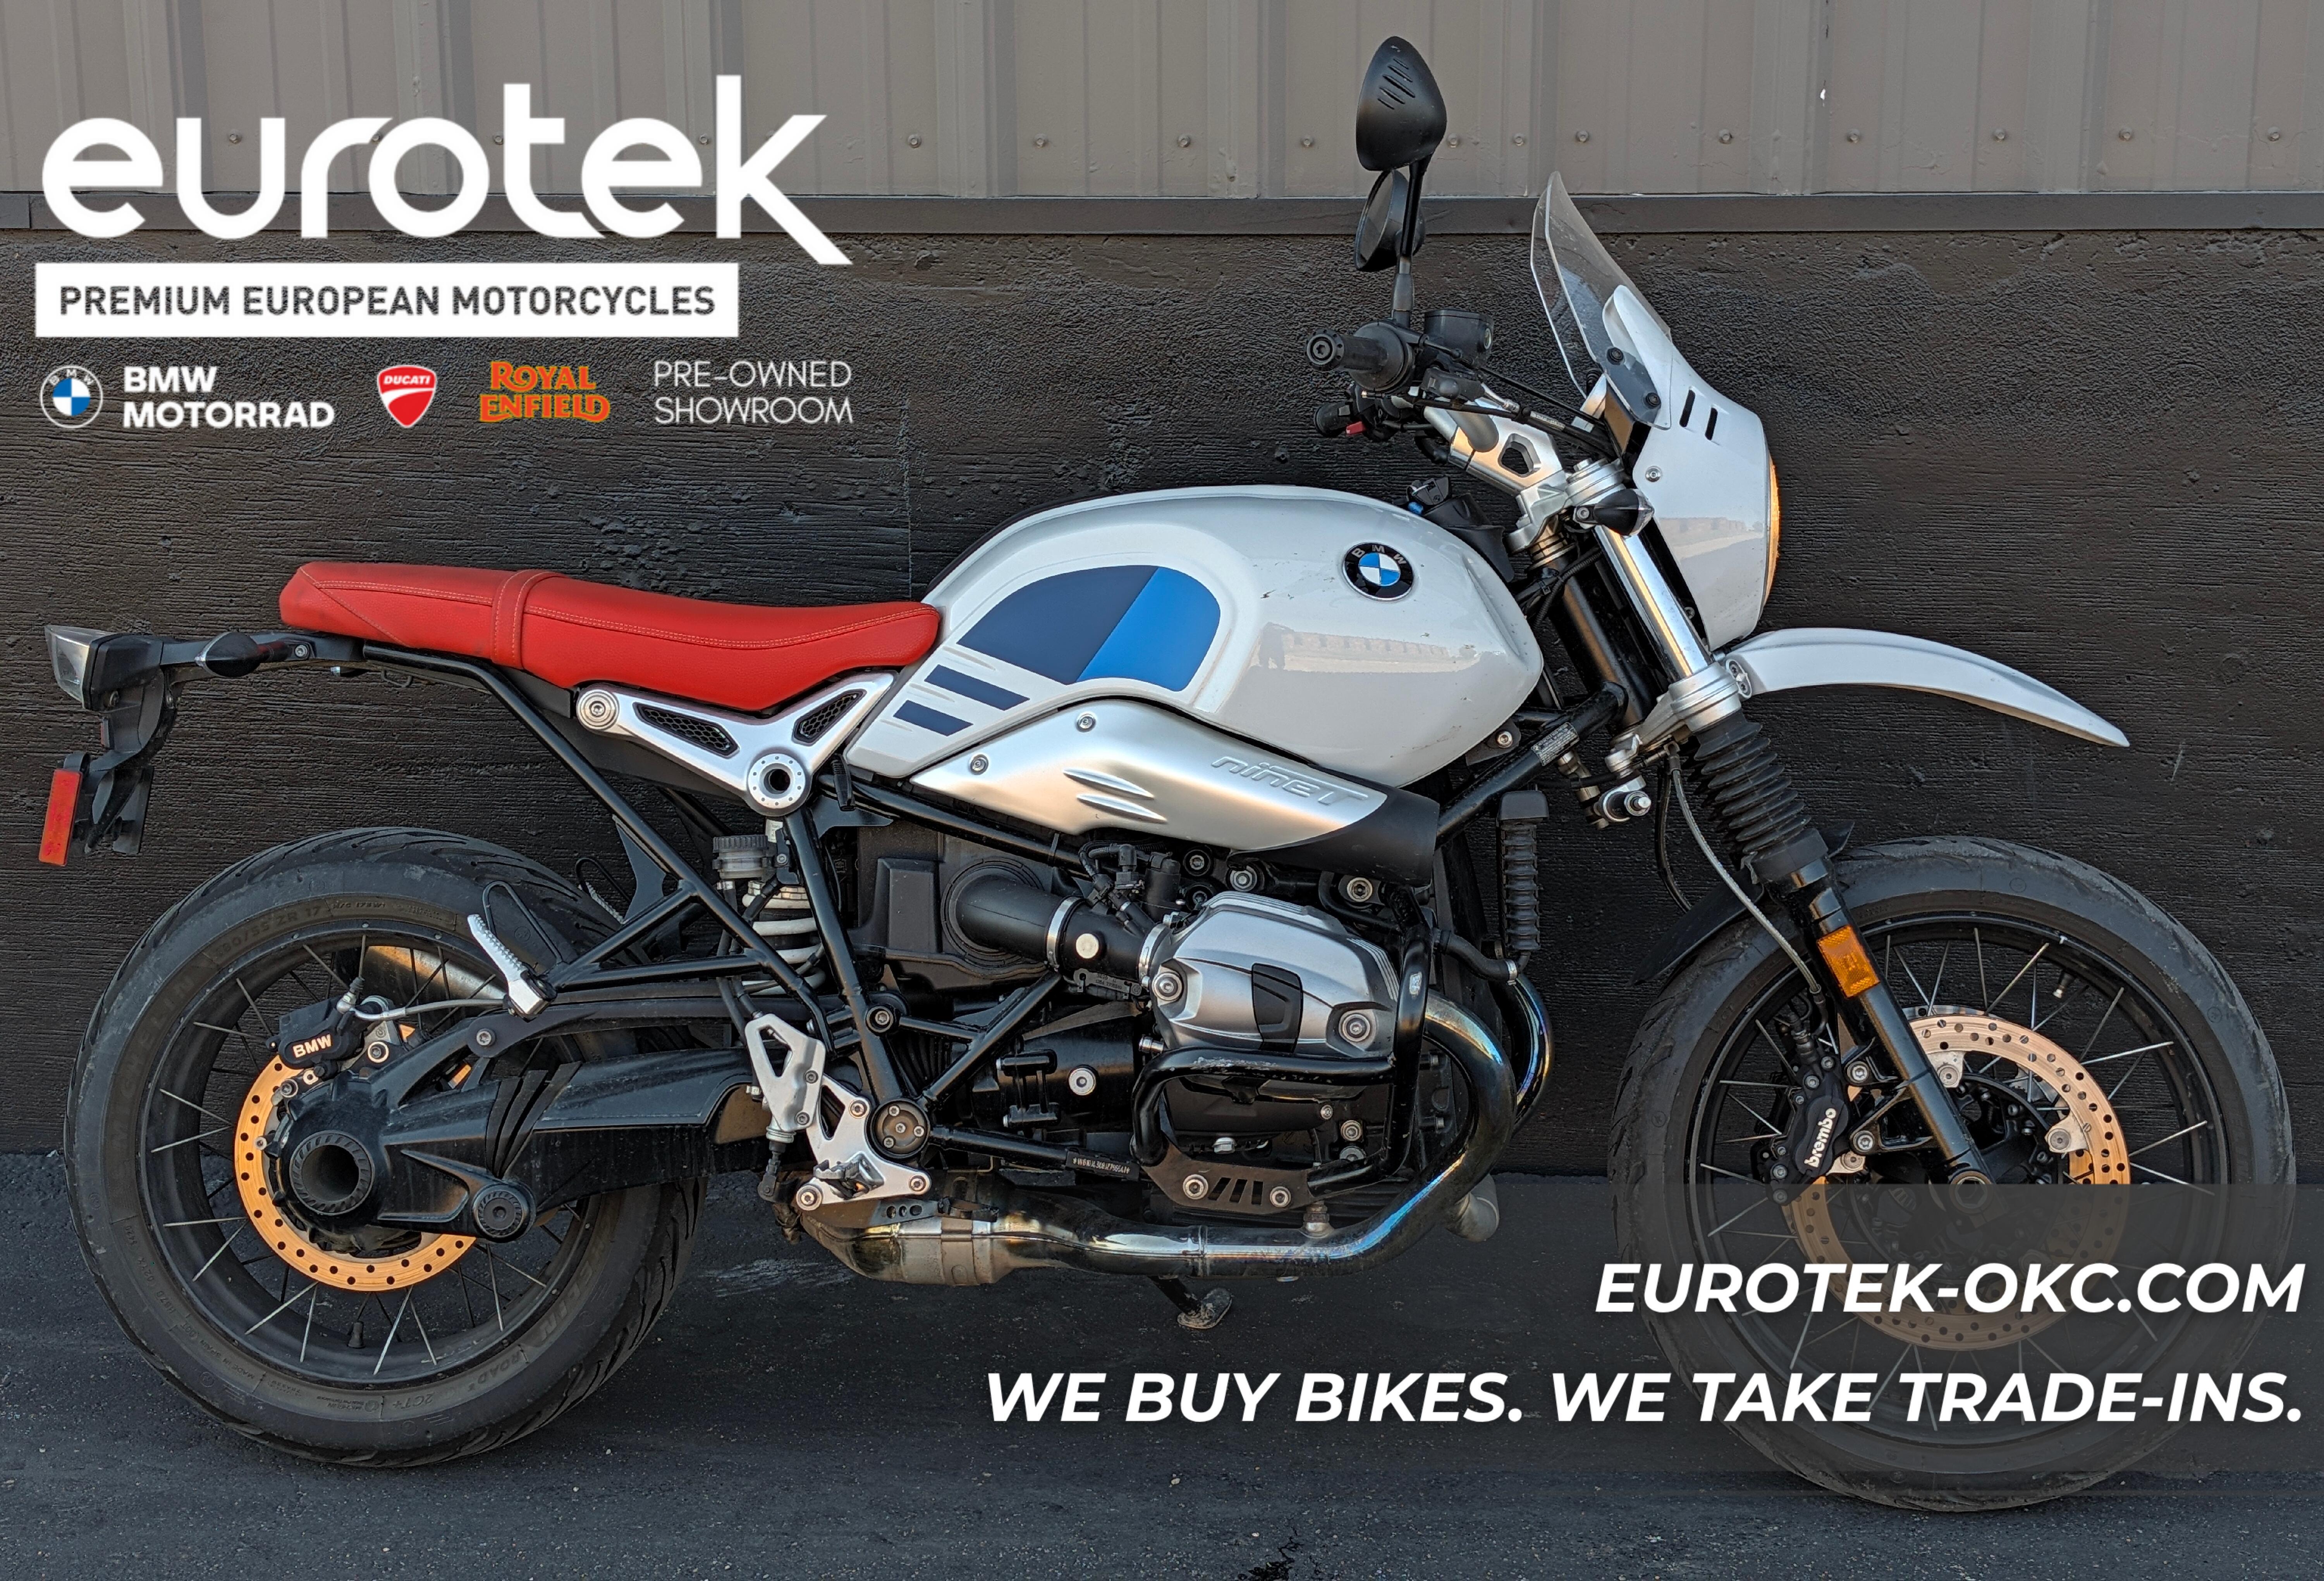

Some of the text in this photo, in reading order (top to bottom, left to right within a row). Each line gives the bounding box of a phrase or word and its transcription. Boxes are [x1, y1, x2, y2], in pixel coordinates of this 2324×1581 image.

[1351, 544, 1407, 564] BMW
[293, 1033, 332, 1058] BMW
[1803, 1108, 1837, 1168] brembo
[198, 1338, 222, 1360] SPAIN
[231, 1363, 255, 1381] MADE
[475, 1350, 526, 1387] ROAD
